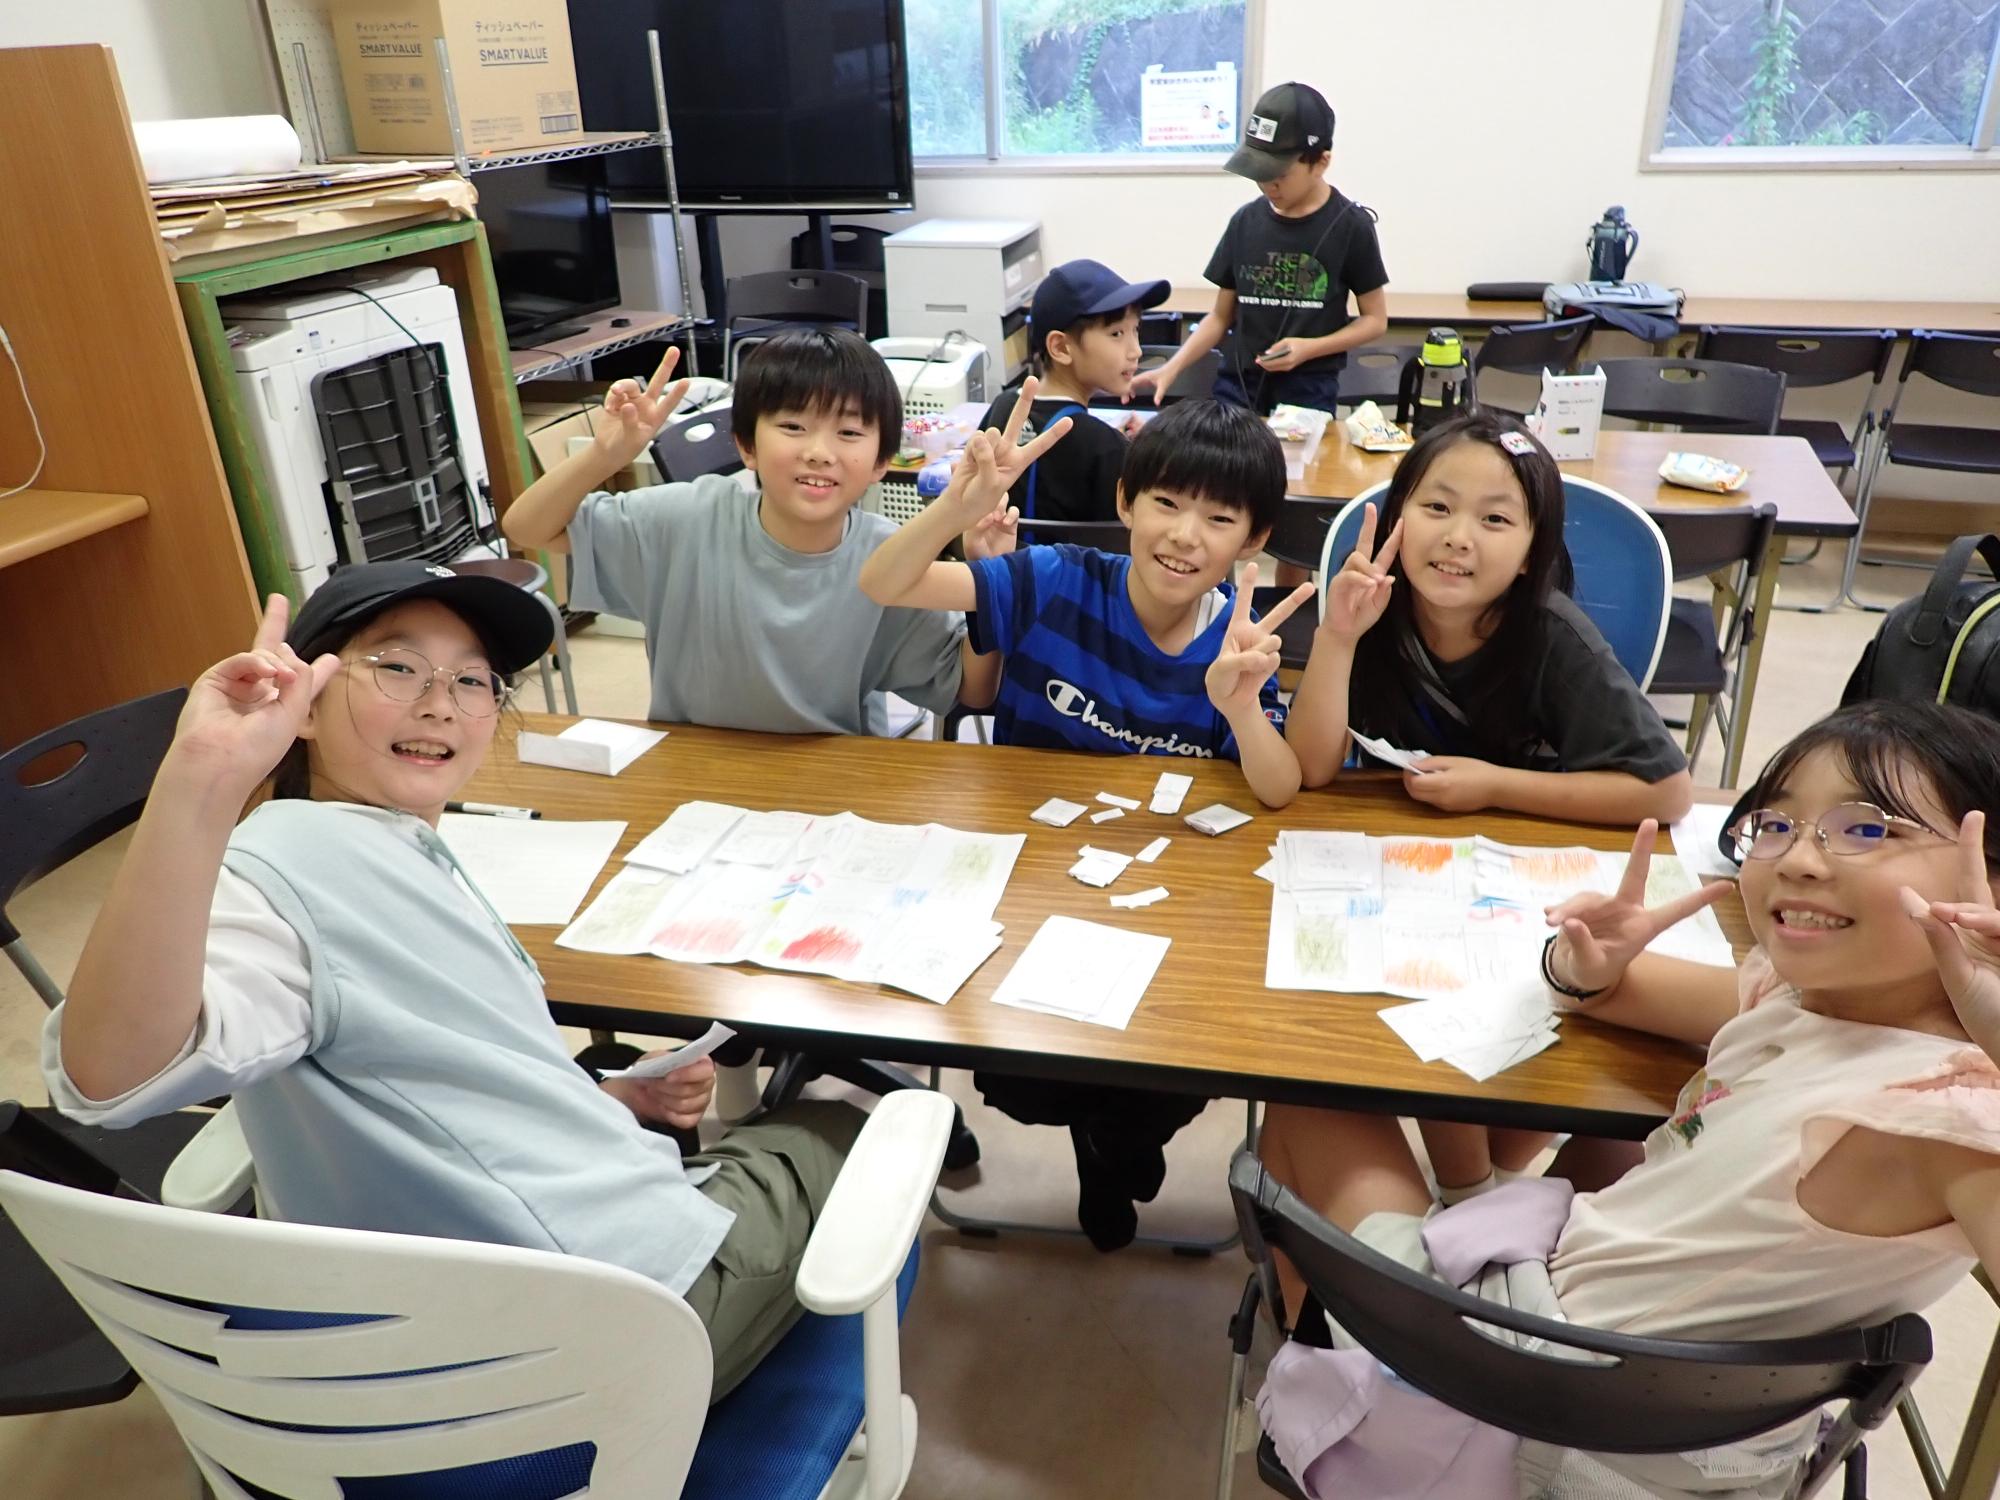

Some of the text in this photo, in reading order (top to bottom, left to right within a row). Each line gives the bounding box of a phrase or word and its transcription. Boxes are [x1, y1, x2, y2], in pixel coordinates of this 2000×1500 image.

[475, 20, 544, 33] ティッシュペーパー
[360, 43, 422, 54] SMARTVALUE
[480, 47, 548, 62] SMARTVALUE
[1266, 252, 1299, 269] THE
[1046, 679, 1214, 759] Champion
